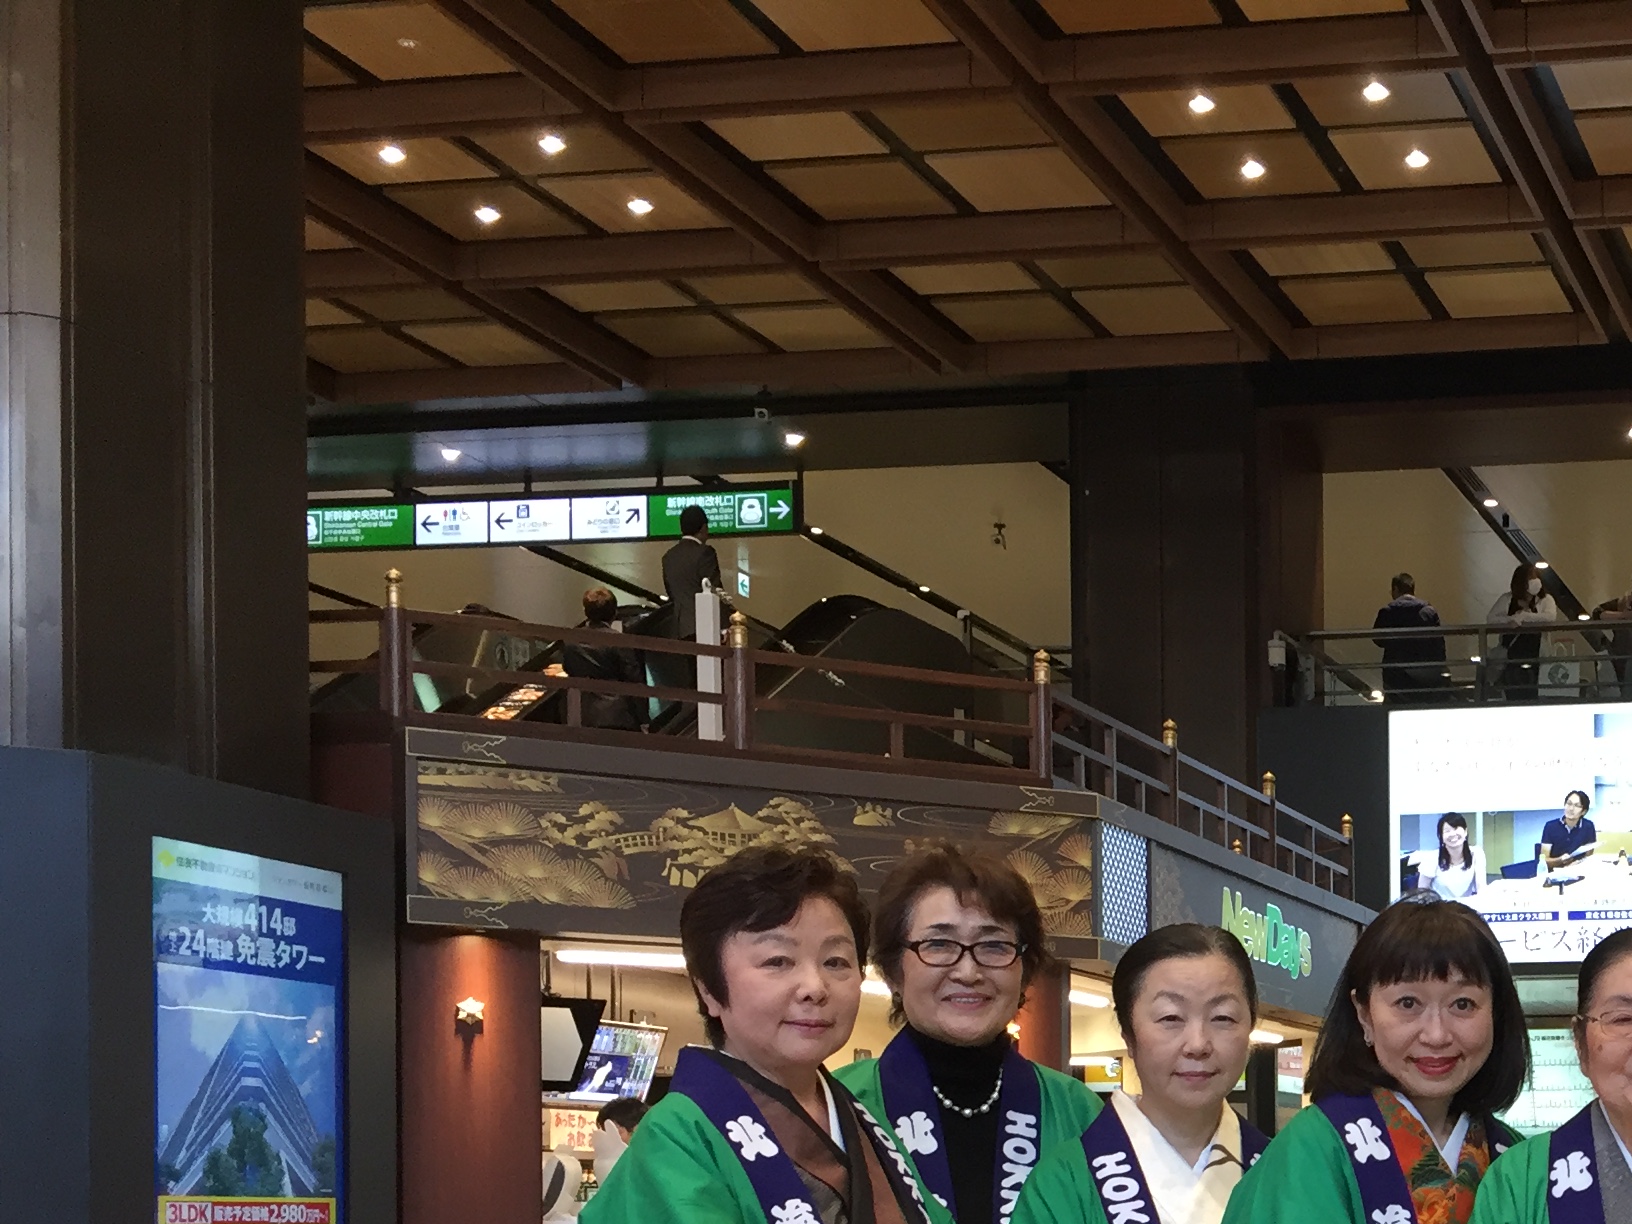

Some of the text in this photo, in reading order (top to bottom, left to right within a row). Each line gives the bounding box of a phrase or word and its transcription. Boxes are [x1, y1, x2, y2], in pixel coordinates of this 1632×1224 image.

[324, 509, 398, 521] 新幹線中央改札口
[236, 933, 325, 970] 免震タワー
[168, 1203, 209, 1223] 3LDK
